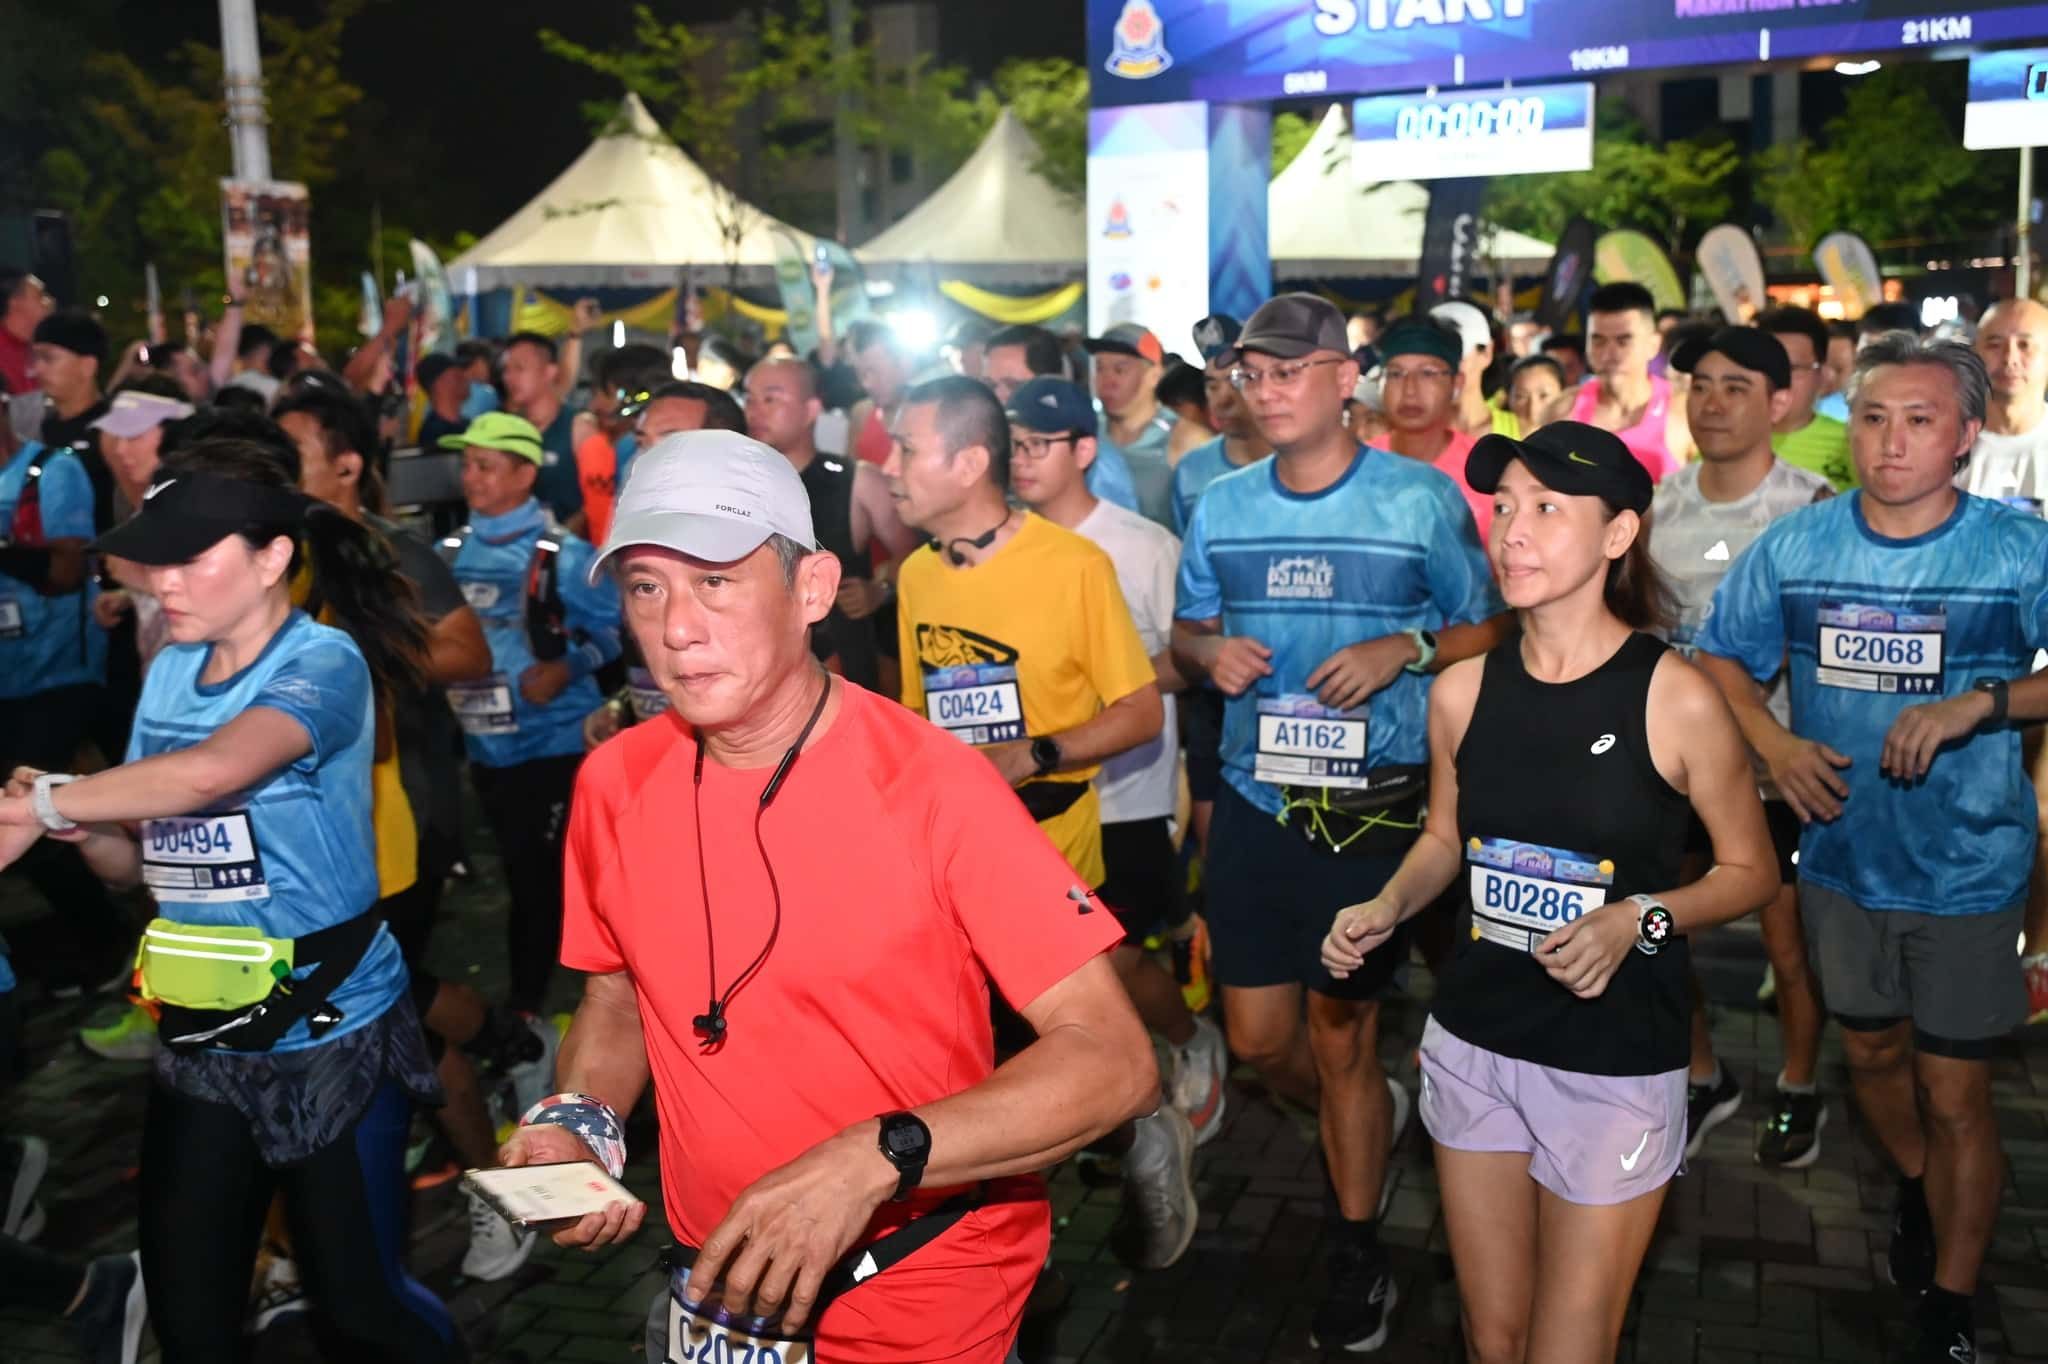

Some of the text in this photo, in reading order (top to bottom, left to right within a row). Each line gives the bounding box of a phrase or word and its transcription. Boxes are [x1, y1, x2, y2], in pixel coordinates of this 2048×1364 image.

[1902, 16, 1972, 44] 21KM
[1396, 97, 1544, 139] 00:00:00
[715, 504, 752, 518] FORCLAZ
[1835, 633, 1923, 665] C2068
[939, 689, 1003, 719] C0424
[1275, 721, 1346, 750] A1162
[152, 820, 232, 853] D0494
[1485, 874, 1584, 925] B0286
